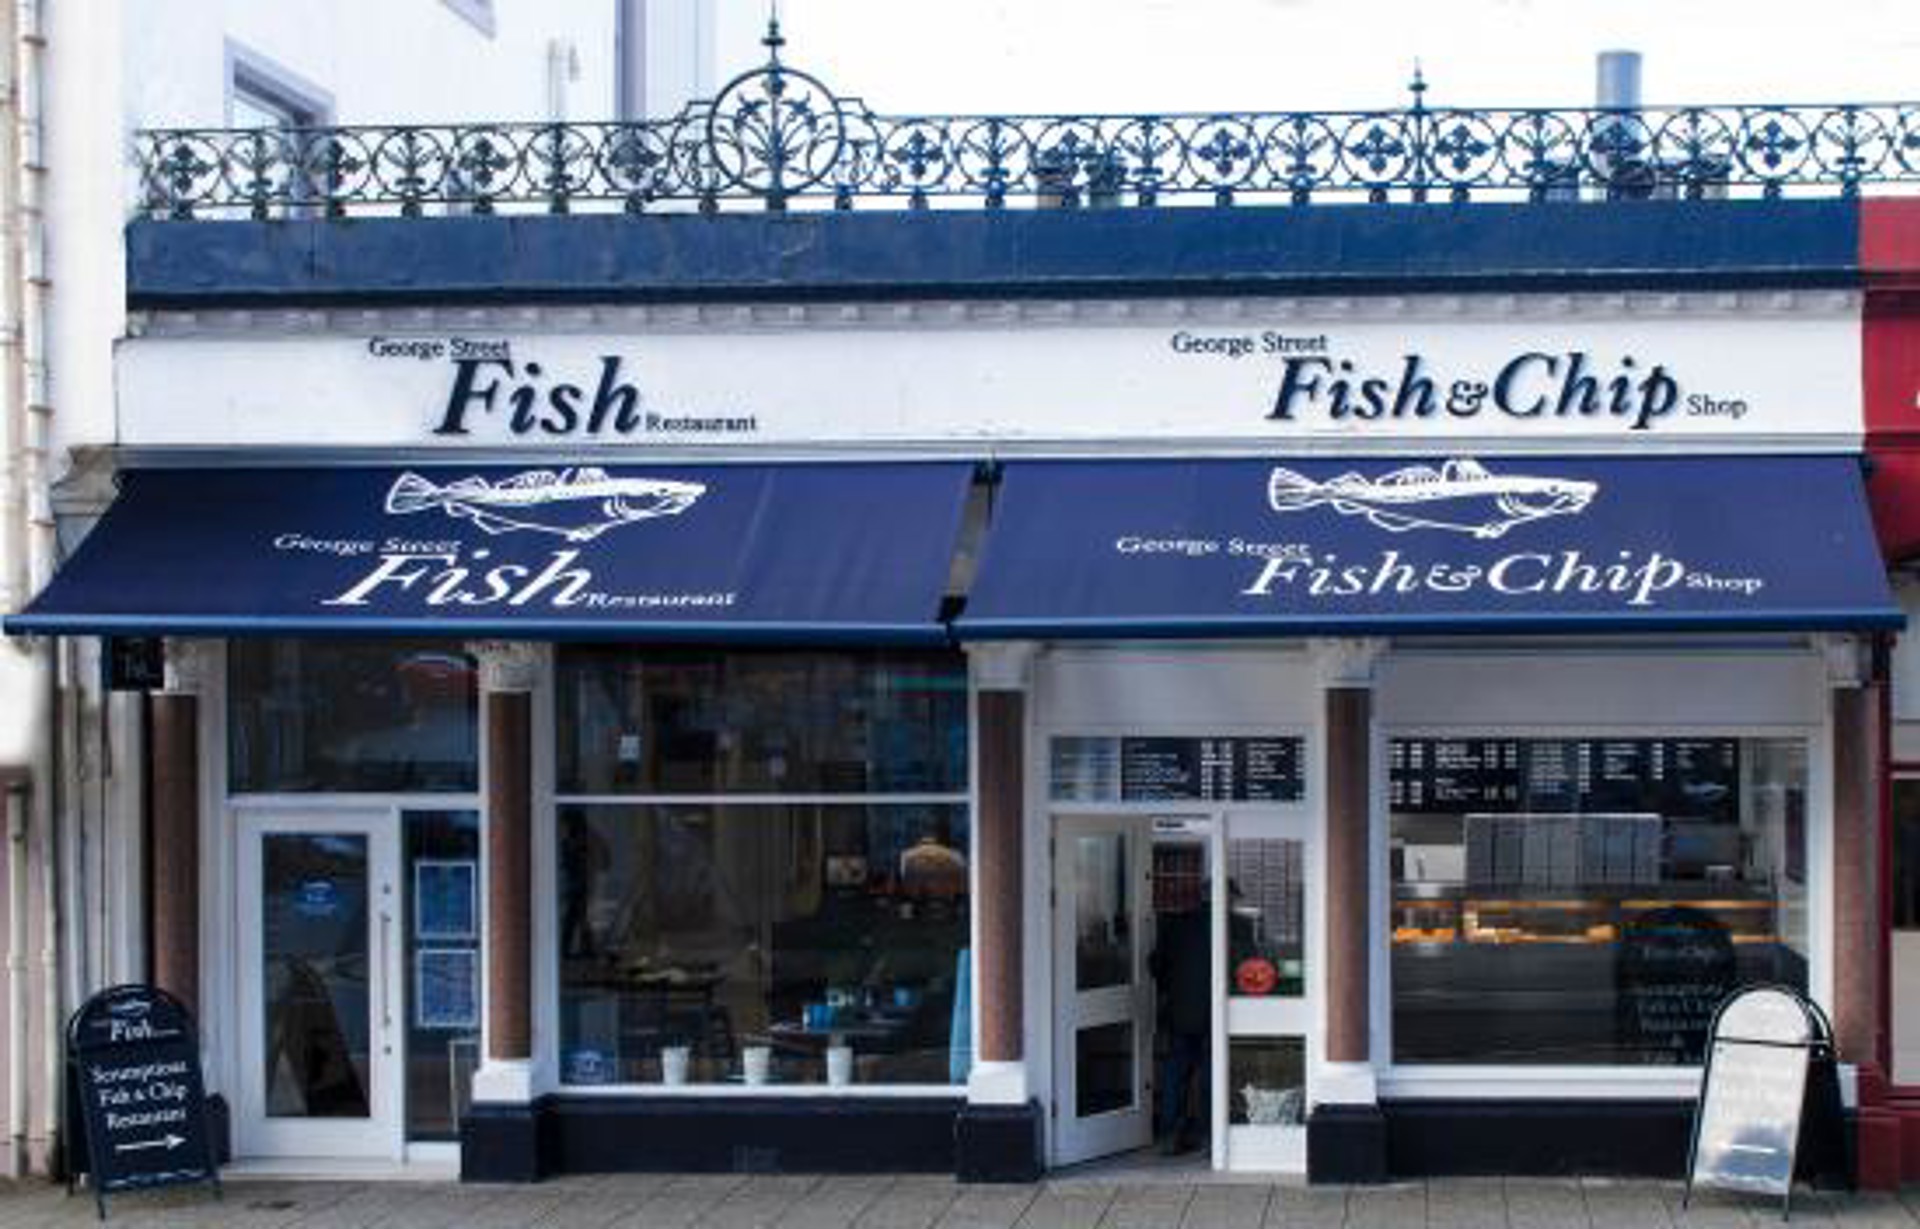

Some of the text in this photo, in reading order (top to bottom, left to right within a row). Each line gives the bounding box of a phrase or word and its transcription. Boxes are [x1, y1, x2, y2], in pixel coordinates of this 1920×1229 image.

[370, 335, 511, 360] George Street
[1172, 331, 1327, 357] George Street
[432, 355, 757, 436] Fish Restaurant
[1686, 393, 1748, 419] Shop
[273, 534, 462, 556] George Street
[1116, 537, 1311, 558] George Street
[321, 549, 737, 608] Fish Restaurant
[1685, 572, 1763, 595] Shop
